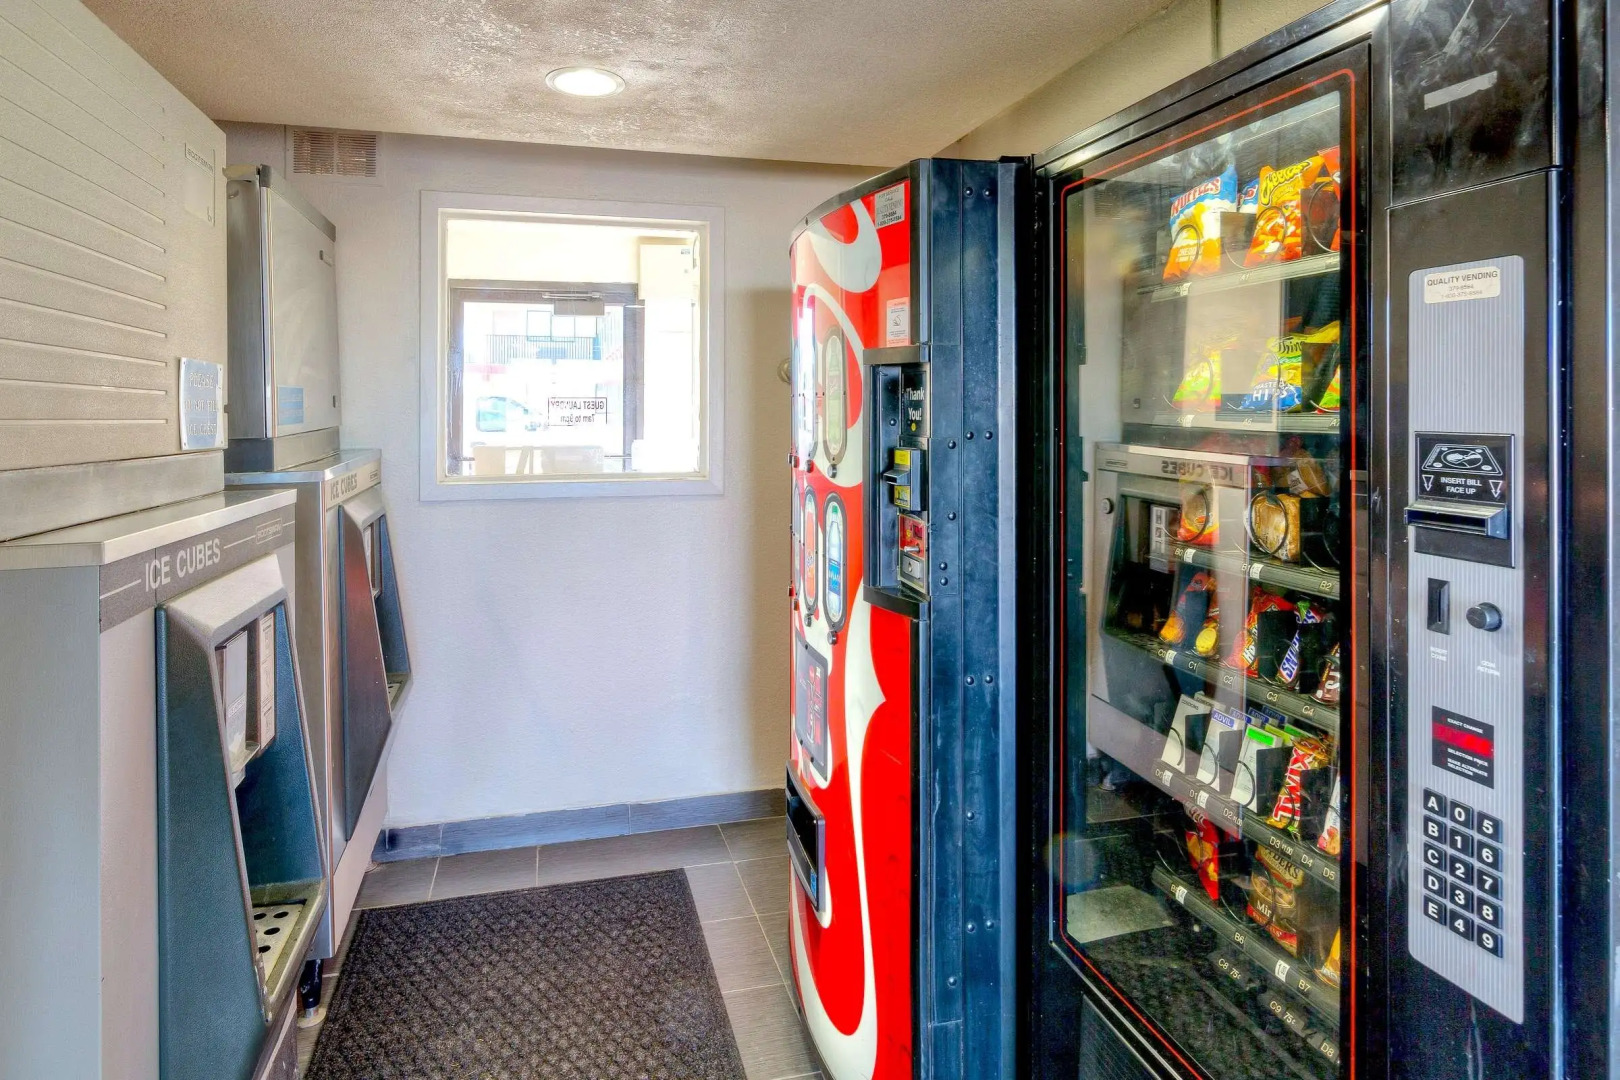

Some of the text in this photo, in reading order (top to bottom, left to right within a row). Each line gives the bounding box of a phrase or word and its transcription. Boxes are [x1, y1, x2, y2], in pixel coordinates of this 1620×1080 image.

[1427, 271, 1498, 286] QUALITY VENDING
[905, 387, 925, 400] Thank
[908, 407, 922, 420] You!
[330, 480, 339, 501] ICE
[341, 472, 357, 496] CUBES
[1440, 477, 1465, 485] INSERT
[145, 538, 221, 592] ICE CUBES
[1319, 580, 1332, 591] B2
[1188, 661, 1197, 669] C1
[1223, 675, 1233, 684] C2
[1266, 691, 1278, 702] C3
[1302, 705, 1314, 715] C4
[1213, 712, 1231, 727] ADVIL
[1273, 747, 1314, 822] TWIX
[1222, 808, 1233, 818] D2
[1427, 796, 1493, 834] A 0 5
[1269, 836, 1280, 848] D3
[1428, 821, 1493, 863] B 1 6
[1301, 854, 1313, 868] D4
[1322, 867, 1335, 880] D5
[1427, 849, 1493, 890] C 2 7
[1428, 875, 1493, 920] D 3 8
[1428, 902, 1494, 949] E 4 9
[1234, 932, 1244, 944] B6
[1218, 958, 1229, 970] C8
[1298, 979, 1311, 992] B7
[1269, 1001, 1281, 1013] C9
[1320, 1042, 1334, 1057] D8
